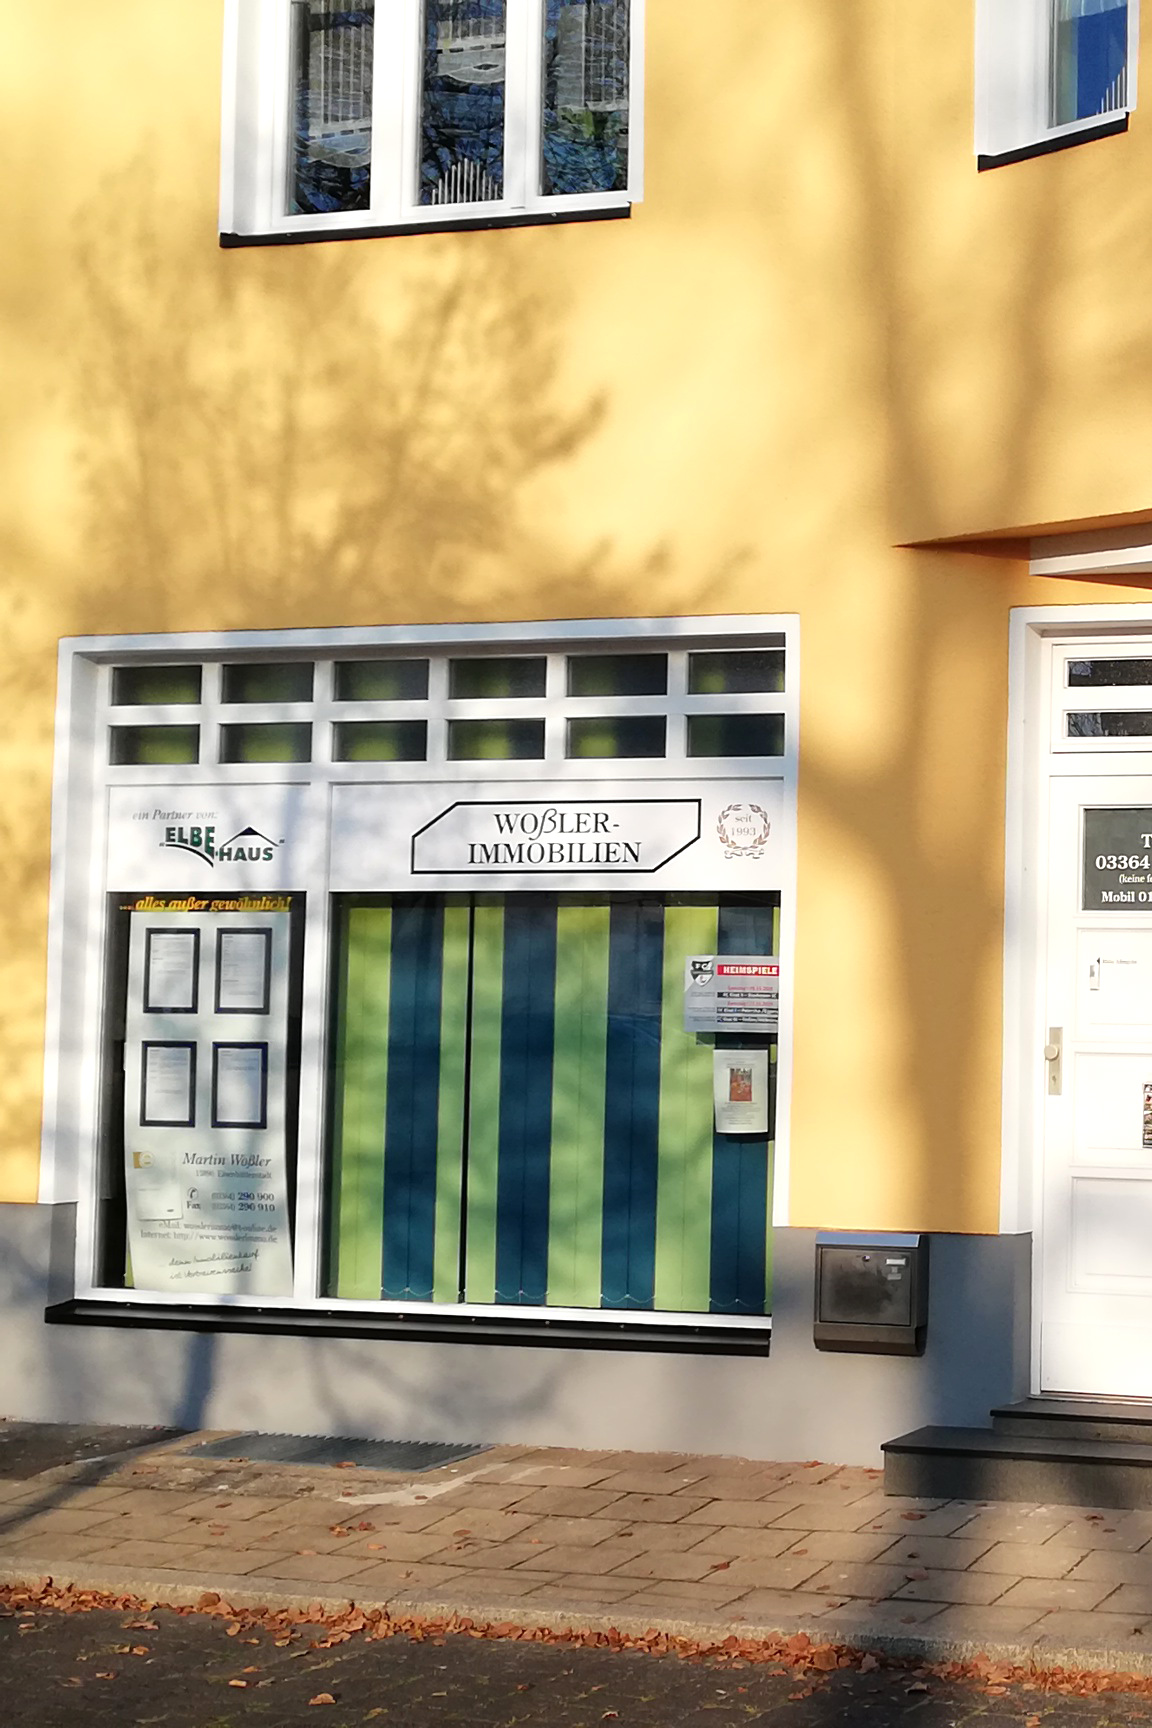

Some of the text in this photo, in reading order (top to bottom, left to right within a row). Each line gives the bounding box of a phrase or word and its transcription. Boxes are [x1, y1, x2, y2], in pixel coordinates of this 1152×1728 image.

[132, 811, 149, 820] ein
[152, 809, 193, 821] Partner
[735, 814, 752, 823] seit
[493, 808, 620, 840] WOßLER-
[731, 827, 756, 836] 1993
[467, 841, 642, 865] IMMOBILIEN
[1095, 855, 1151, 870] 03364
[1119, 874, 1145, 884] (keine
[1101, 891, 1135, 903] Mobil
[135, 896, 165, 911] alles
[168, 896, 209, 912] außer
[723, 966, 778, 975] HEIMSPIELE
[182, 1152, 272, 1169] Martin Woßler
[237, 1192, 255, 1201] 290
[257, 1193, 275, 1201] 900
[237, 1202, 255, 1212] 290
[257, 1203, 276, 1212] 910
